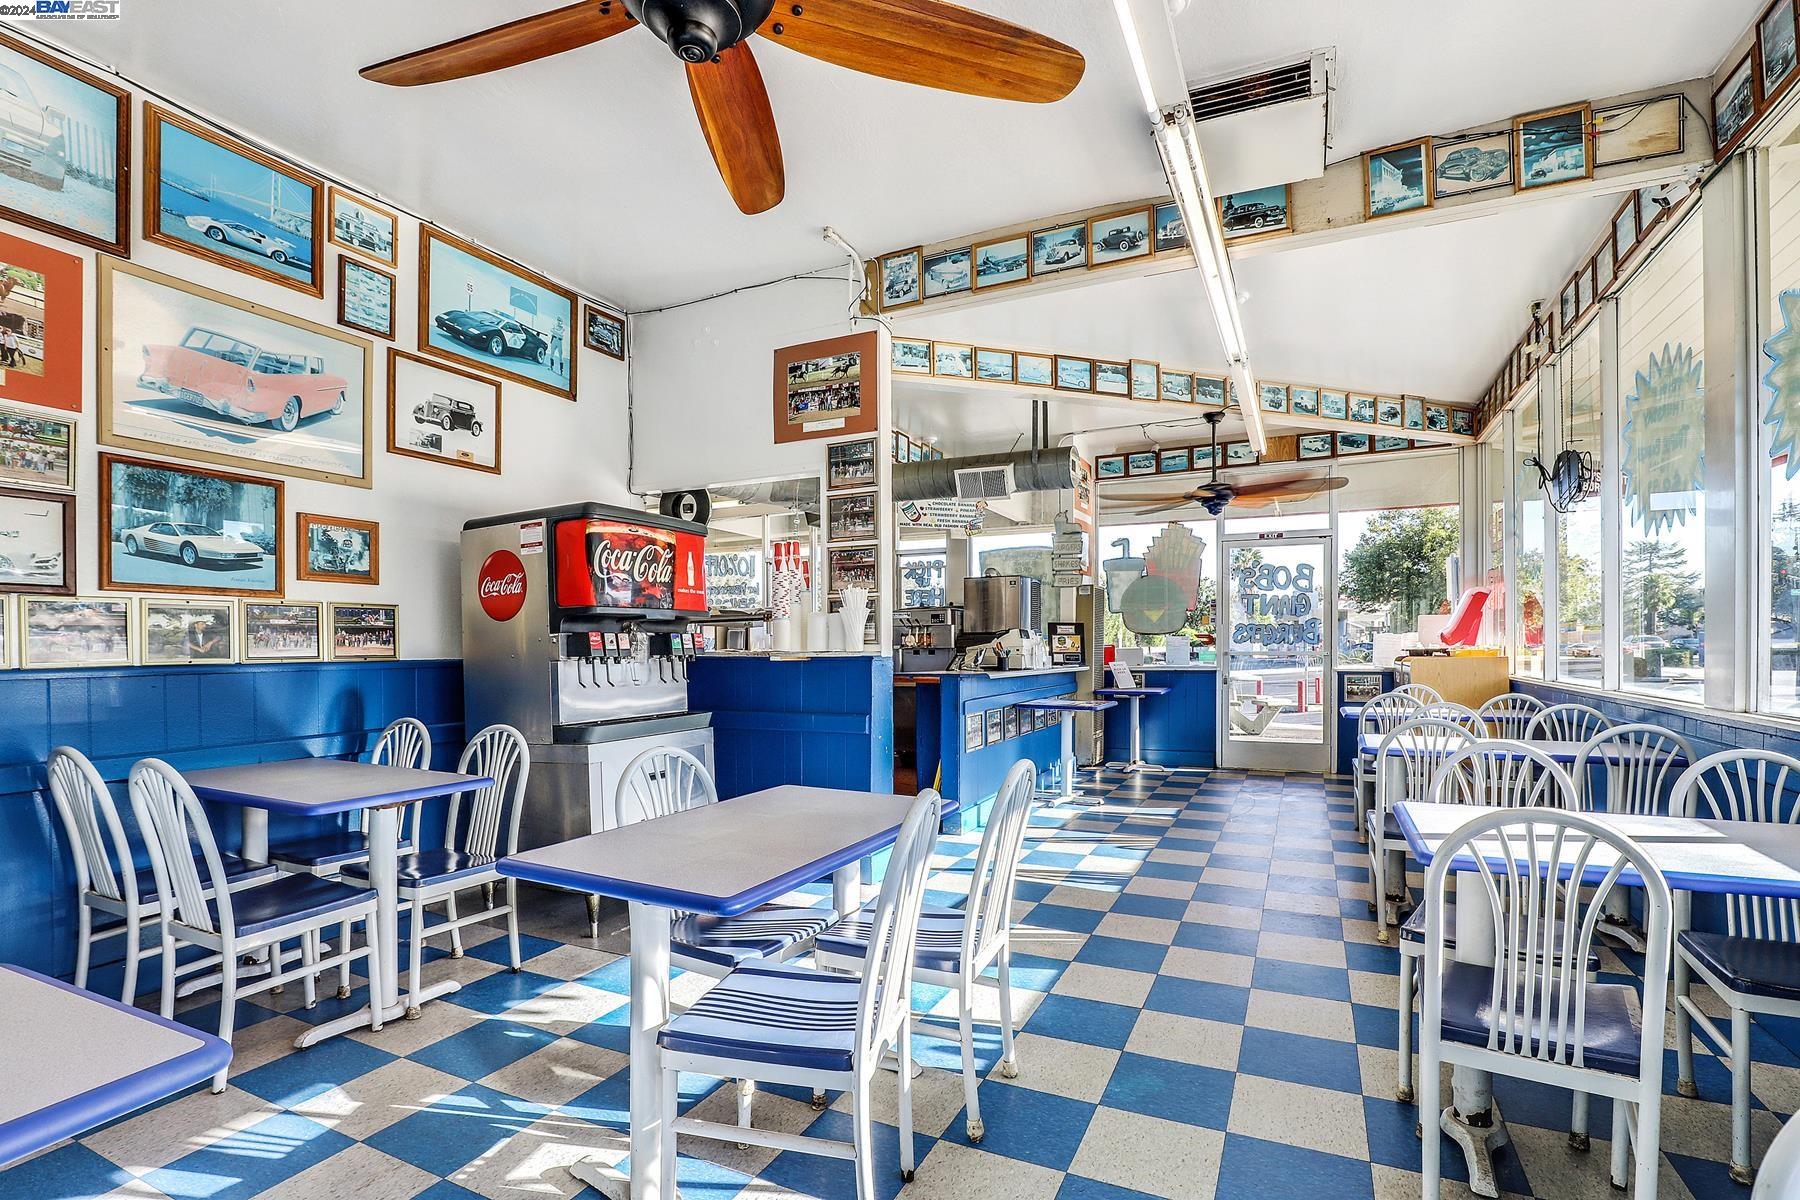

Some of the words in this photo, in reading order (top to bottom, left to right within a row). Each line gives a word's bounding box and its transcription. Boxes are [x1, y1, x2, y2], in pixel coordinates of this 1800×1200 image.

[594, 540, 674, 583] Coca-Cola
[1054, 560, 1079, 568] SHAKES
[480, 572, 524, 598] Coca-Cola
